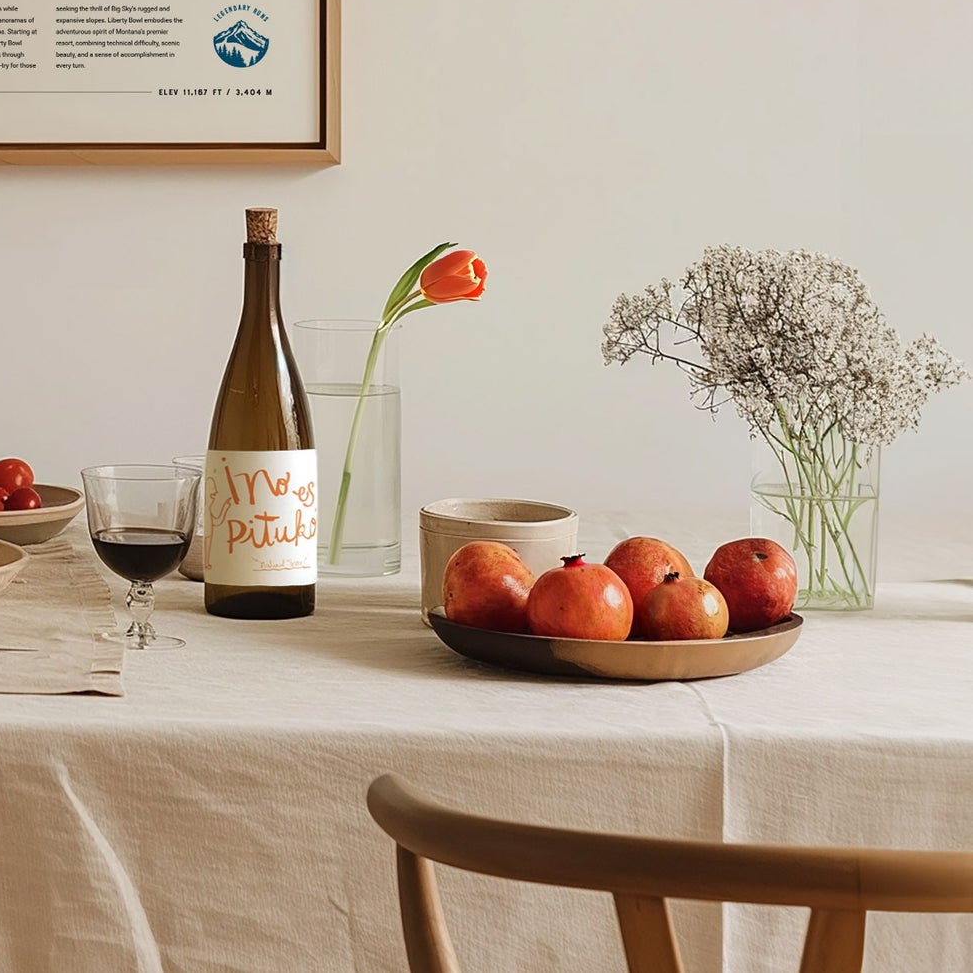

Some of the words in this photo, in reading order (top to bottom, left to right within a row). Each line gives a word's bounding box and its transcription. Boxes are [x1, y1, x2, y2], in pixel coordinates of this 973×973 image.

[56, 5, 79, 13] seeking
[111, 5, 121, 13] Big
[121, 5, 137, 13] Sky's
[137, 5, 158, 13] rugged
[213, 4, 250, 22] LEGENDARY
[253, 7, 269, 22] RUNS
[55, 16, 85, 25] expansive
[107, 16, 128, 25] Liberty
[7, 28, 30, 36] Starting
[92, 28, 107, 36] spirit
[146, 28, 168, 36] premier
[75, 39, 106, 48] combining
[2, 51, 25, 59] through
[120, 51, 168, 59] accomplishment
